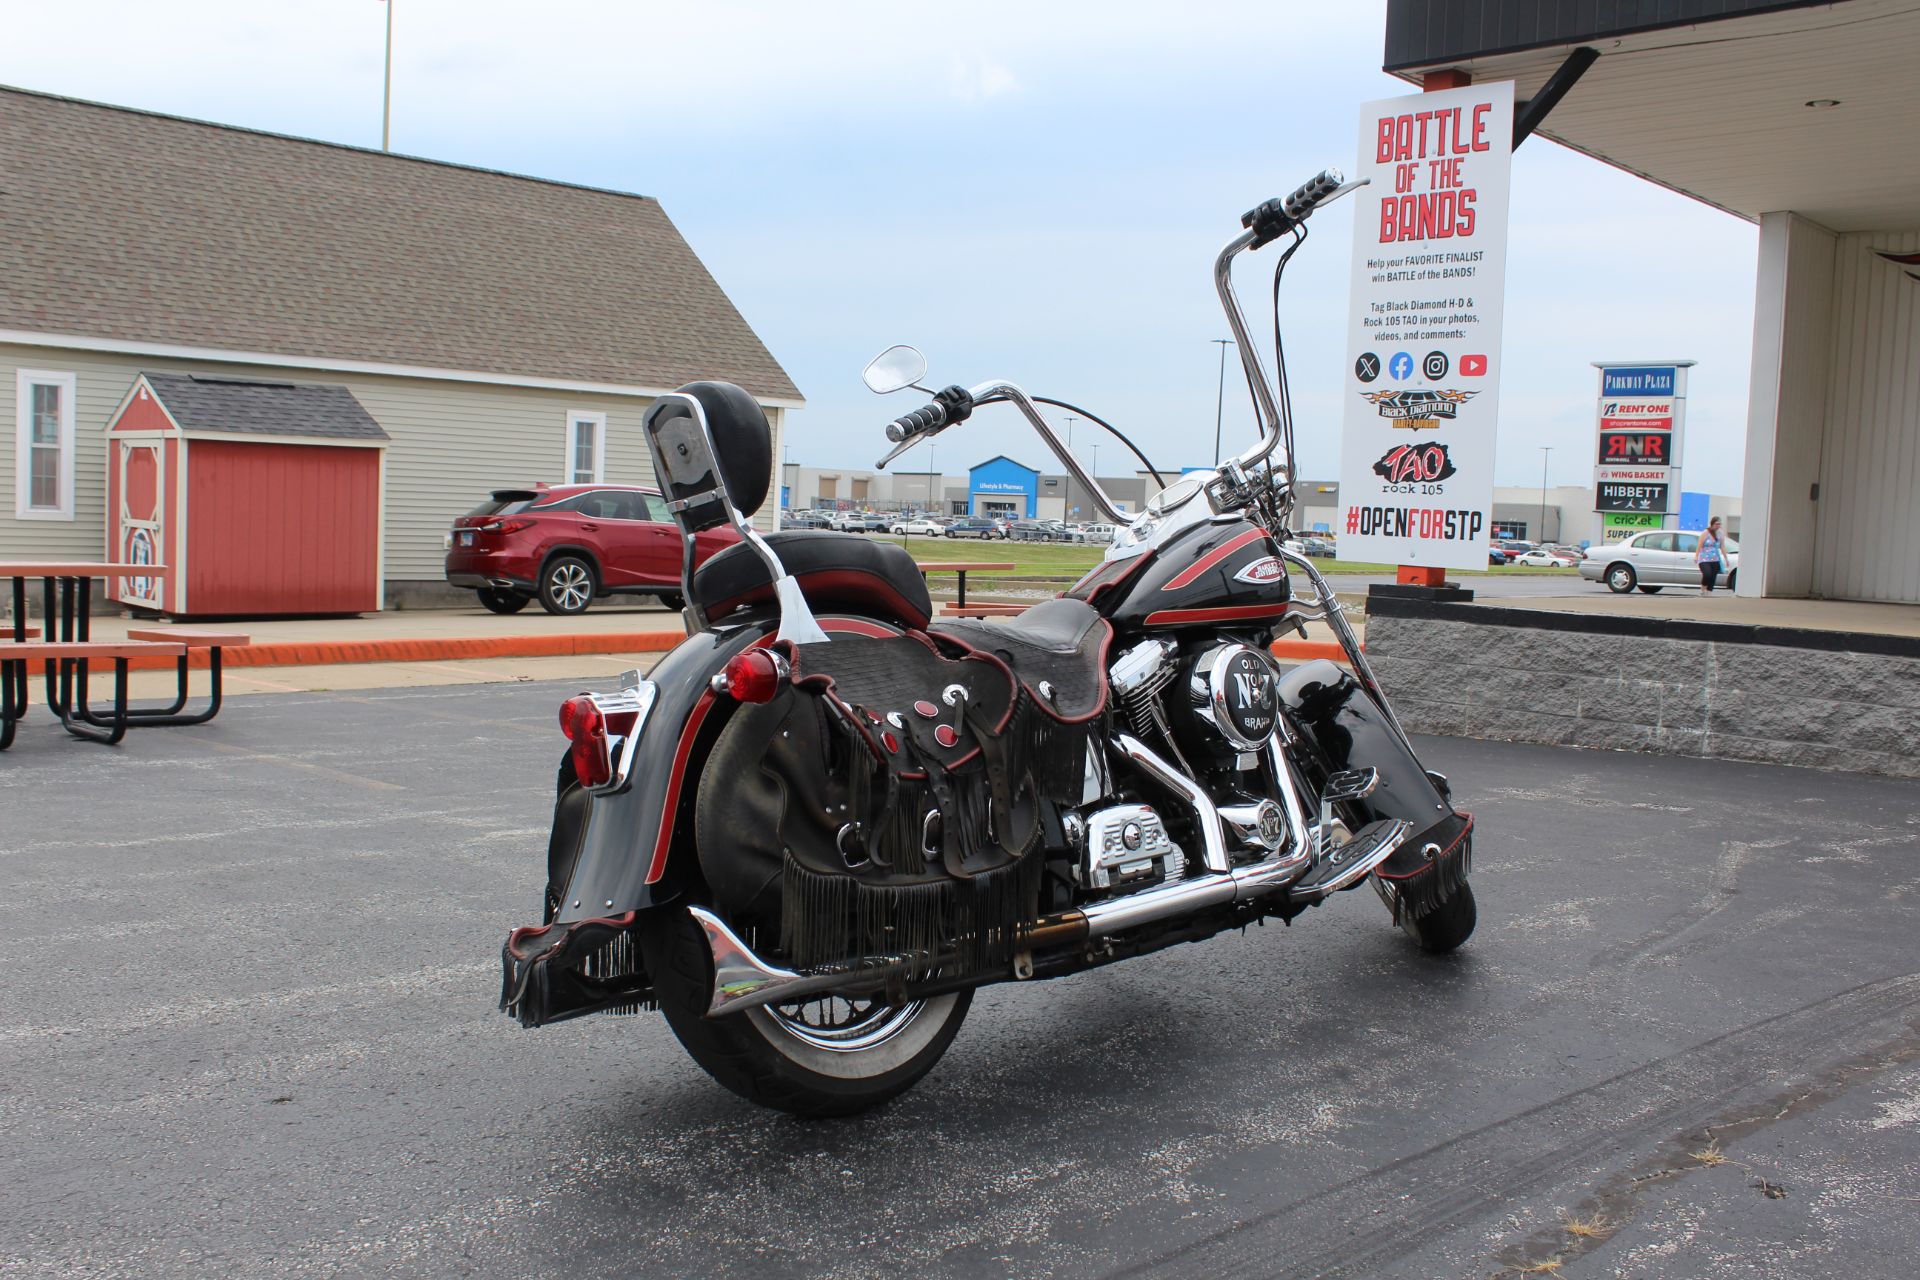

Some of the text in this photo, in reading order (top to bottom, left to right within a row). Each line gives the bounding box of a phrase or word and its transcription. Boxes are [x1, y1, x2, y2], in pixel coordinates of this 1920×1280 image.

[1376, 103, 1491, 163] BATTLE
[1395, 157, 1464, 193] OF THE
[1379, 189, 1477, 243] BANDS
[1367, 251, 1484, 270] Help your FAVORITE FINALIST
[1372, 267, 1476, 283] win BATTLE of the BANDS!
[1371, 298, 1474, 313] Tag Black Diamond H-D &
[1364, 313, 1480, 327] Rock 105 TAO in your photos,
[1374, 329, 1466, 341] videos, and comments:
[1619, 405, 1670, 413] RENT ONE
[1382, 444, 1444, 482] TAO
[1611, 471, 1665, 479] WING BASKET
[1382, 484, 1444, 495] rock 105
[1604, 486, 1661, 498] HIBBETT
[1346, 506, 1482, 541] #OPENFORSTP
[1614, 514, 1652, 525] cricket
[1241, 659, 1259, 669] OLD
